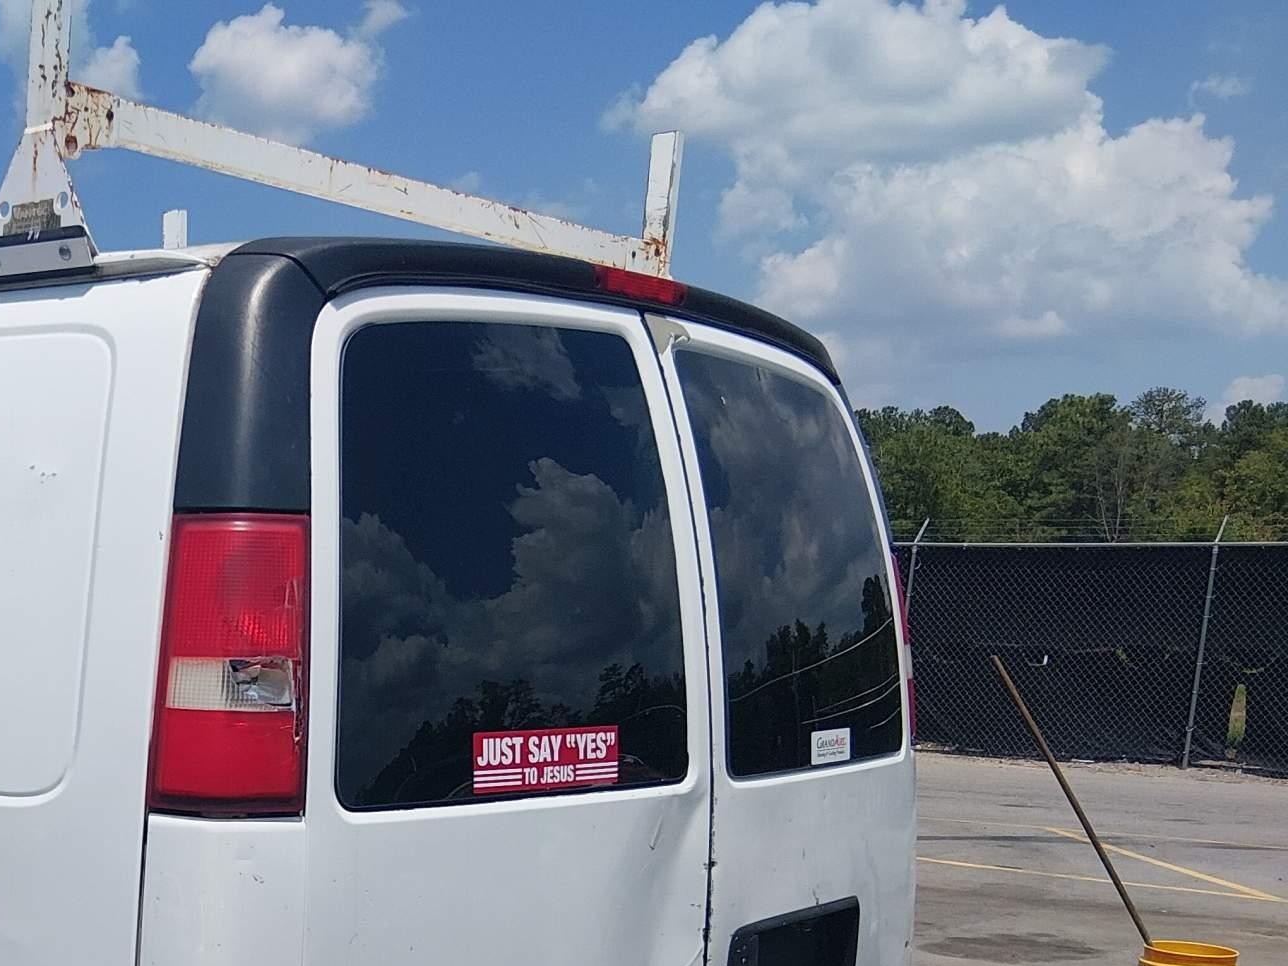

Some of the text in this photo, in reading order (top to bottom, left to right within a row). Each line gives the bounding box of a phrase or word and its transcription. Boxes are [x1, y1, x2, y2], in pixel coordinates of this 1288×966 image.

[477, 736, 523, 766] JUST
[528, 734, 562, 763] SAY
[524, 765, 575, 785] TO JESUS
